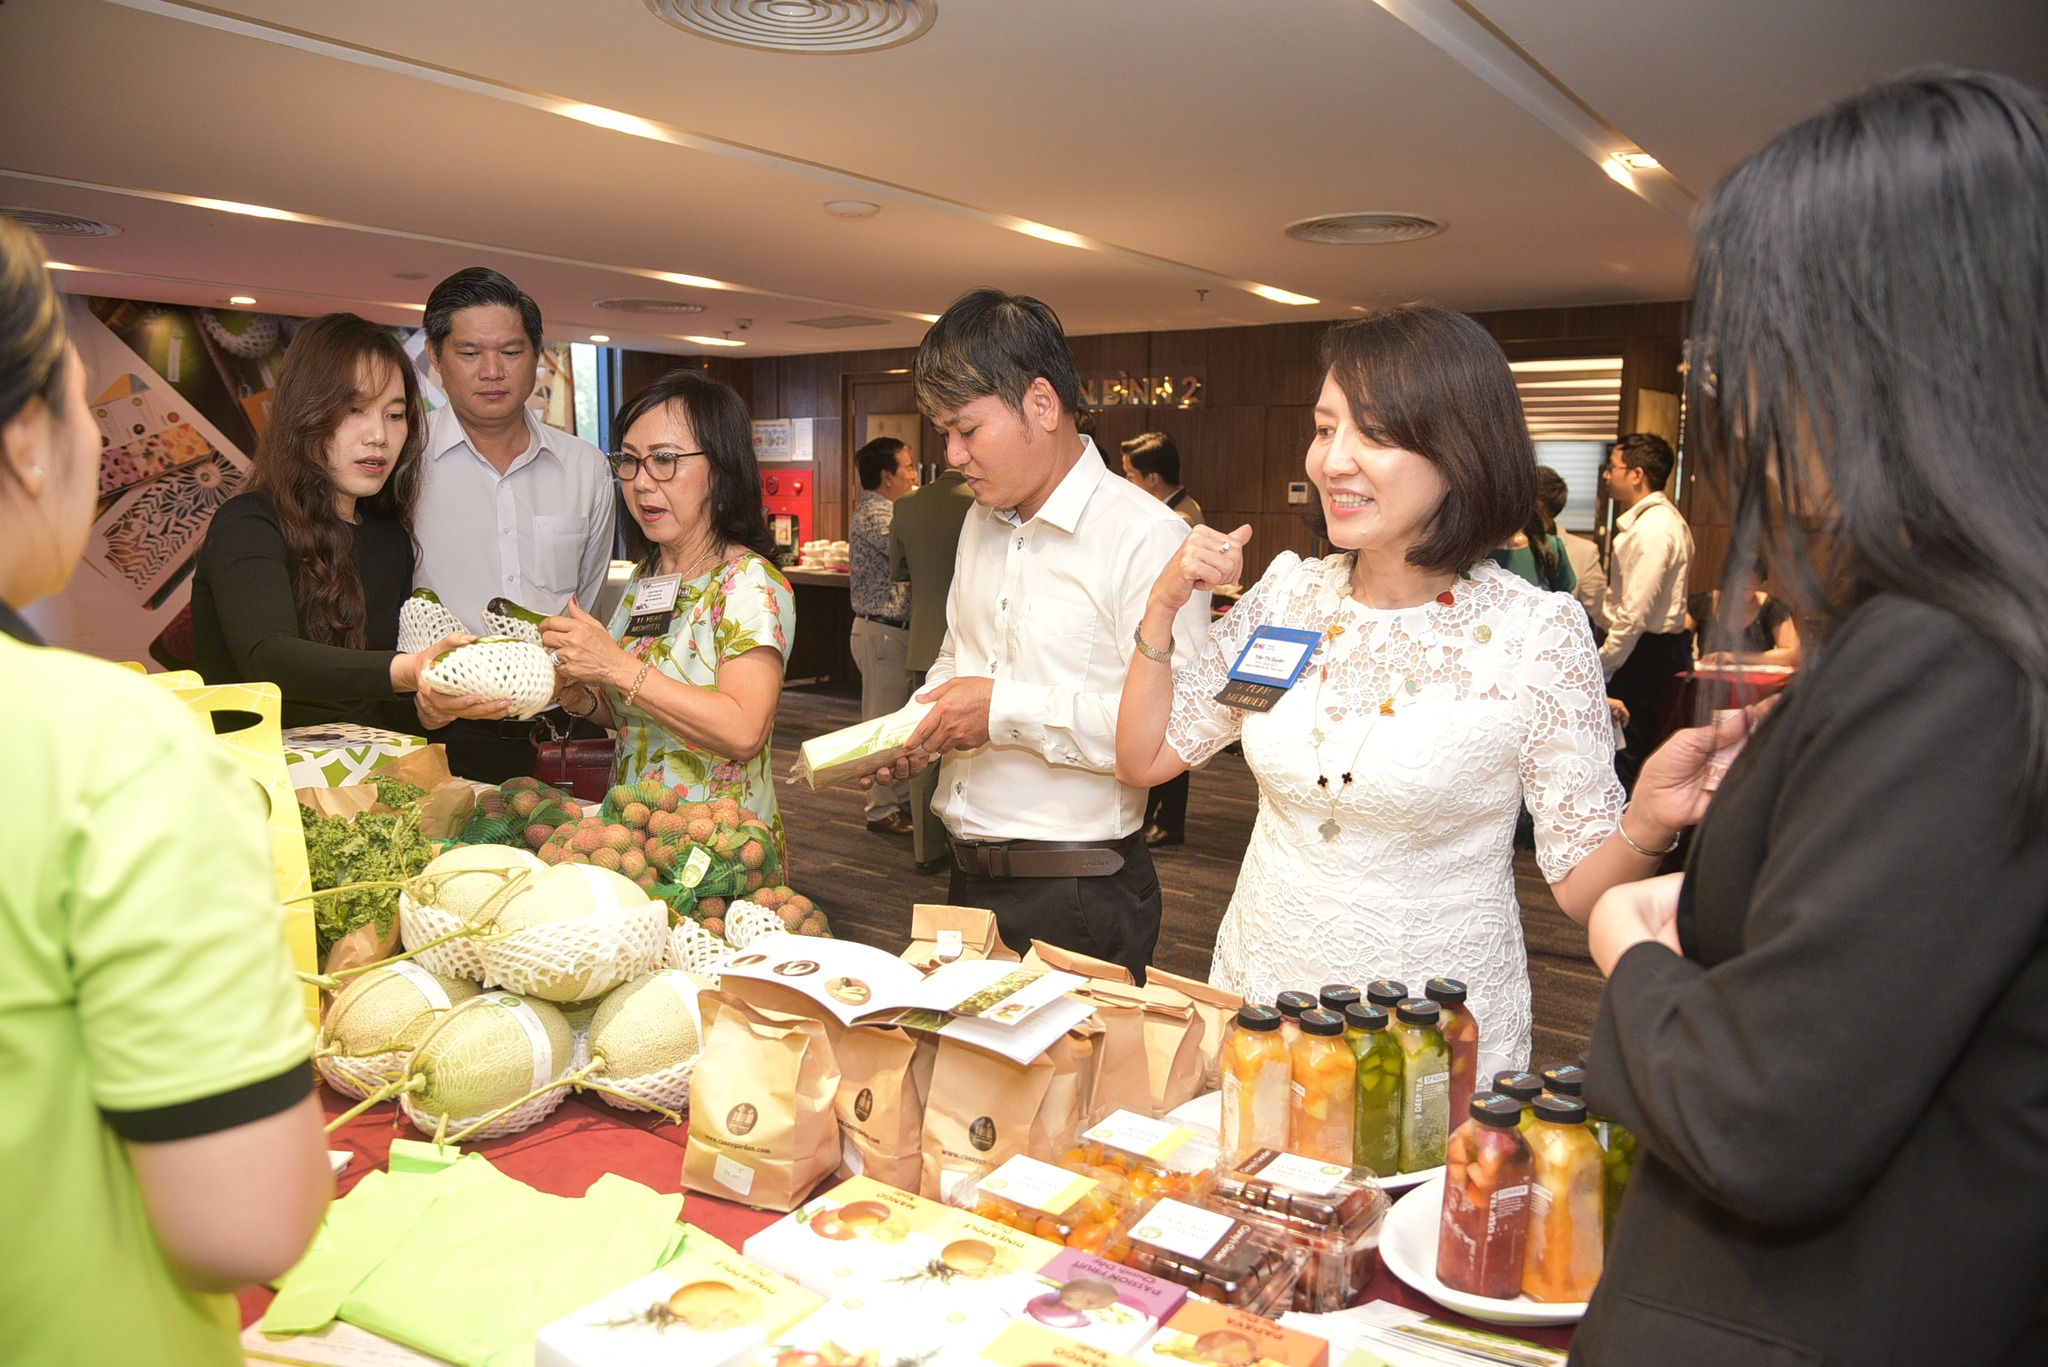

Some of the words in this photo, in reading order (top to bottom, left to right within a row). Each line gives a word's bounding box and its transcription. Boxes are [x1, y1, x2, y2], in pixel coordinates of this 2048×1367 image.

[1102, 370, 1173, 405] BÌNH
[1180, 376, 1200, 404] 2
[646, 614, 663, 623] YEAR
[631, 623, 660, 632] MEMBER
[1246, 683, 1273, 695] YEAR
[1224, 692, 1268, 709] MEMBER
[1415, 1076, 1424, 1092] TEA
[1425, 1073, 1447, 1083] SPRING
[1414, 1093, 1423, 1113] DEEP
[876, 1192, 918, 1210] MANGO
[962, 1223, 1025, 1248] PINEAPPLE
[1072, 1260, 1108, 1279] FRUIT
[1118, 1268, 1156, 1284] Chanh
[1108, 1273, 1162, 1296] PASSION
[1226, 1317, 1284, 1340] PAPAYA
